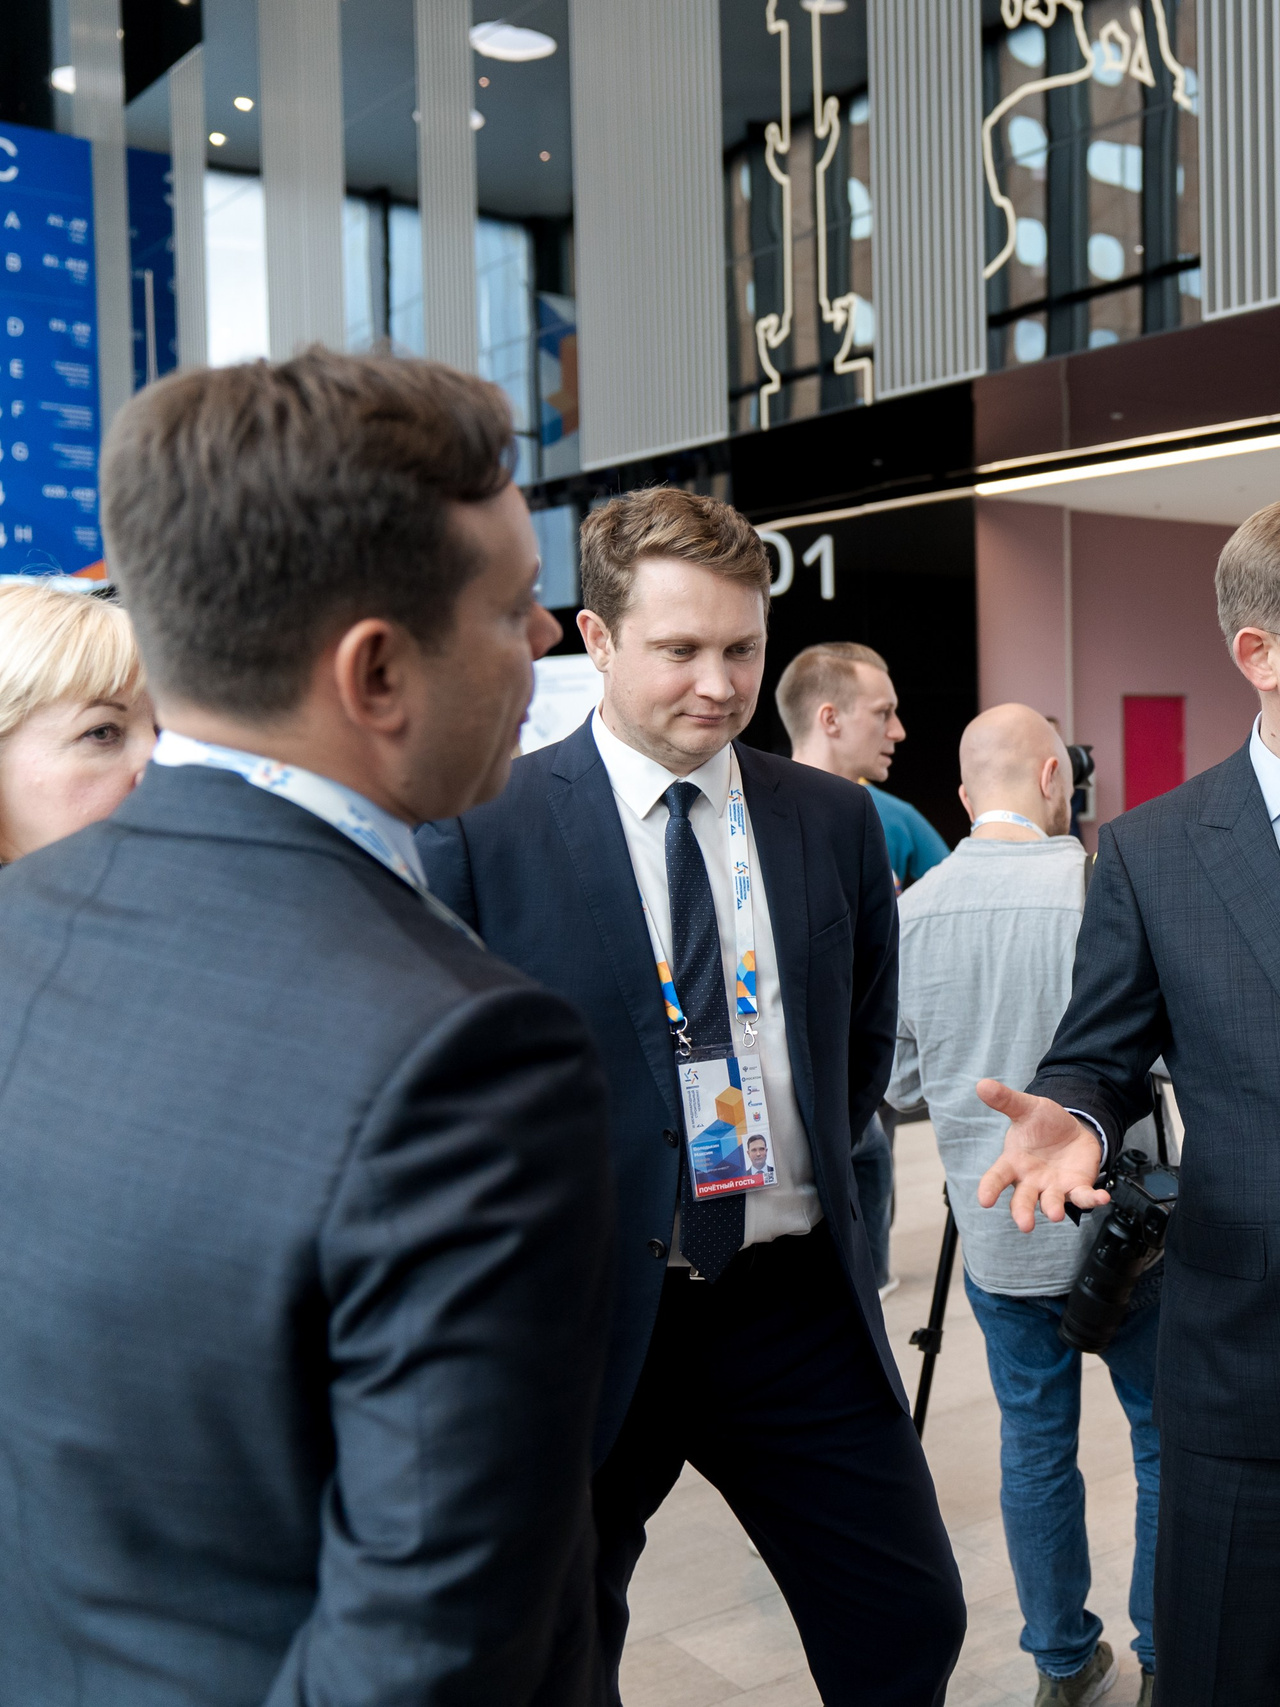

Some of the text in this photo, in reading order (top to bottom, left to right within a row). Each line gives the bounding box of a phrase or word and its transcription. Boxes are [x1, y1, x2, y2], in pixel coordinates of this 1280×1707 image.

[4, 210, 21, 230] A
[14, 524, 33, 543] H
[735, 1177, 756, 1188] ГОСТЬ
